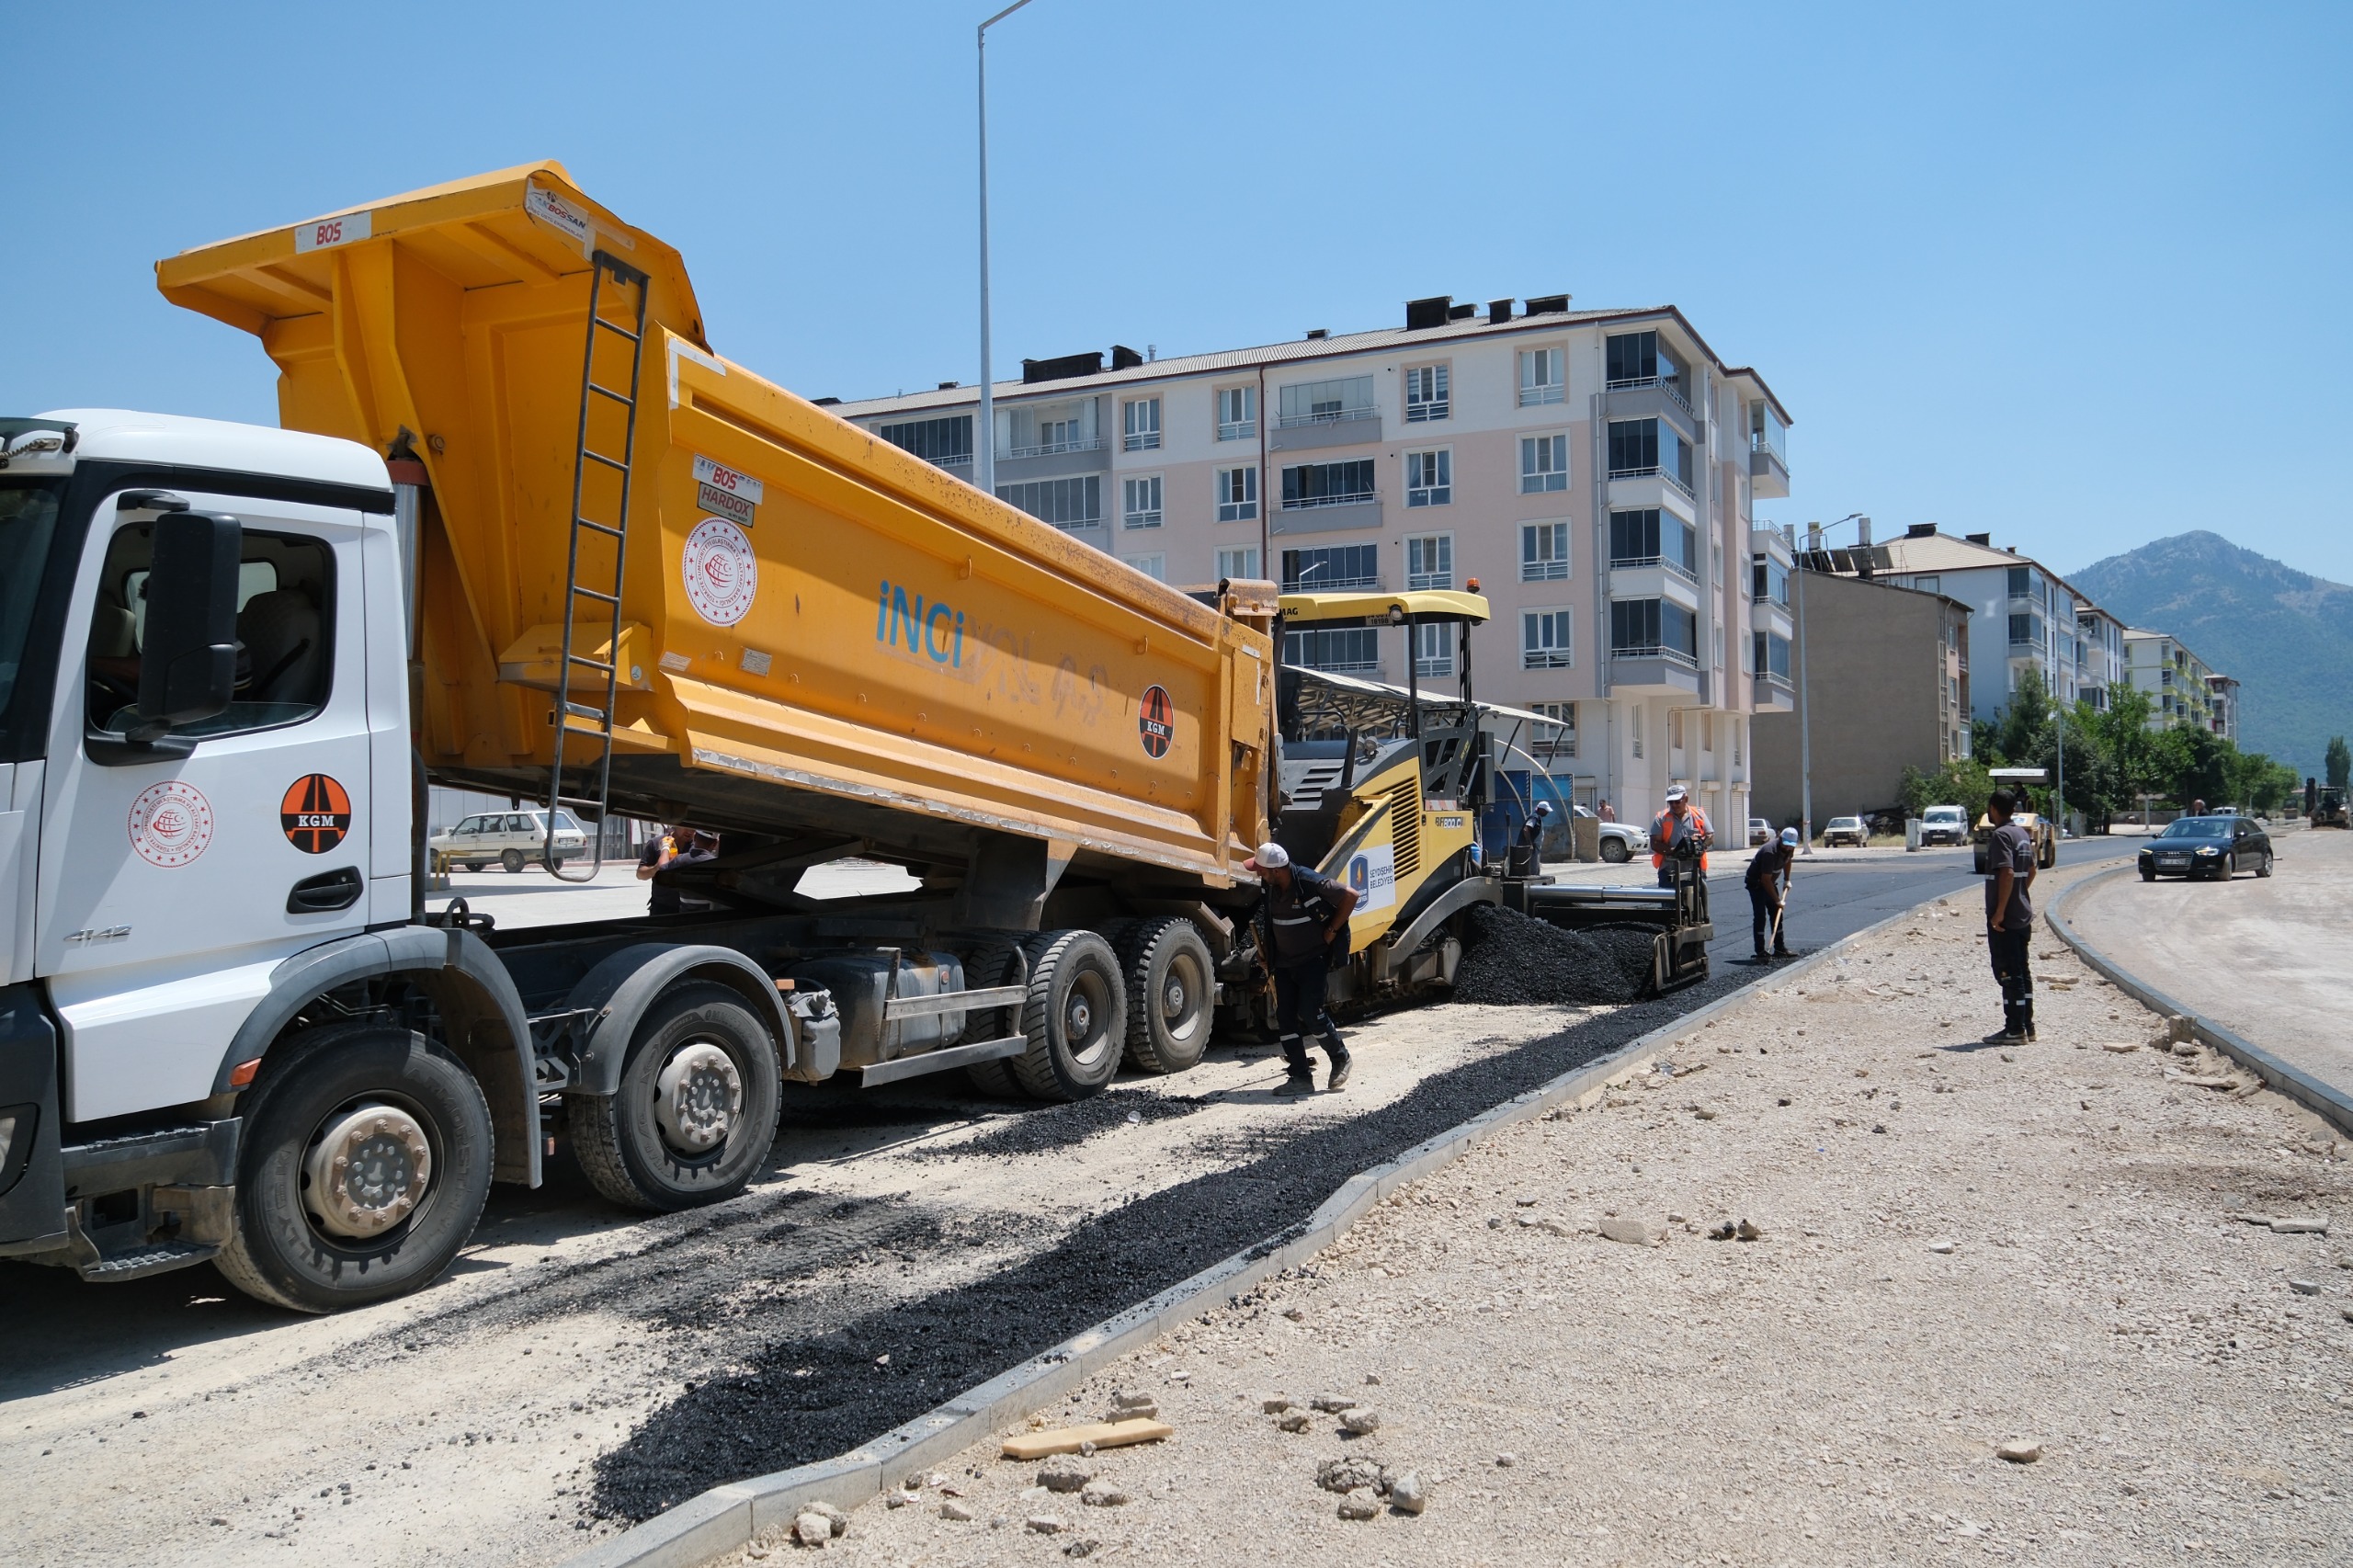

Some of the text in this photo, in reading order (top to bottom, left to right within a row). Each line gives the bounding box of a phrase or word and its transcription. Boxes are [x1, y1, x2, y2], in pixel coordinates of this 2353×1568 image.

[316, 222, 342, 245] BOS
[701, 487, 750, 517] HARDOX
[1147, 721, 1165, 735] KGM
[298, 814, 335, 826] KGM
